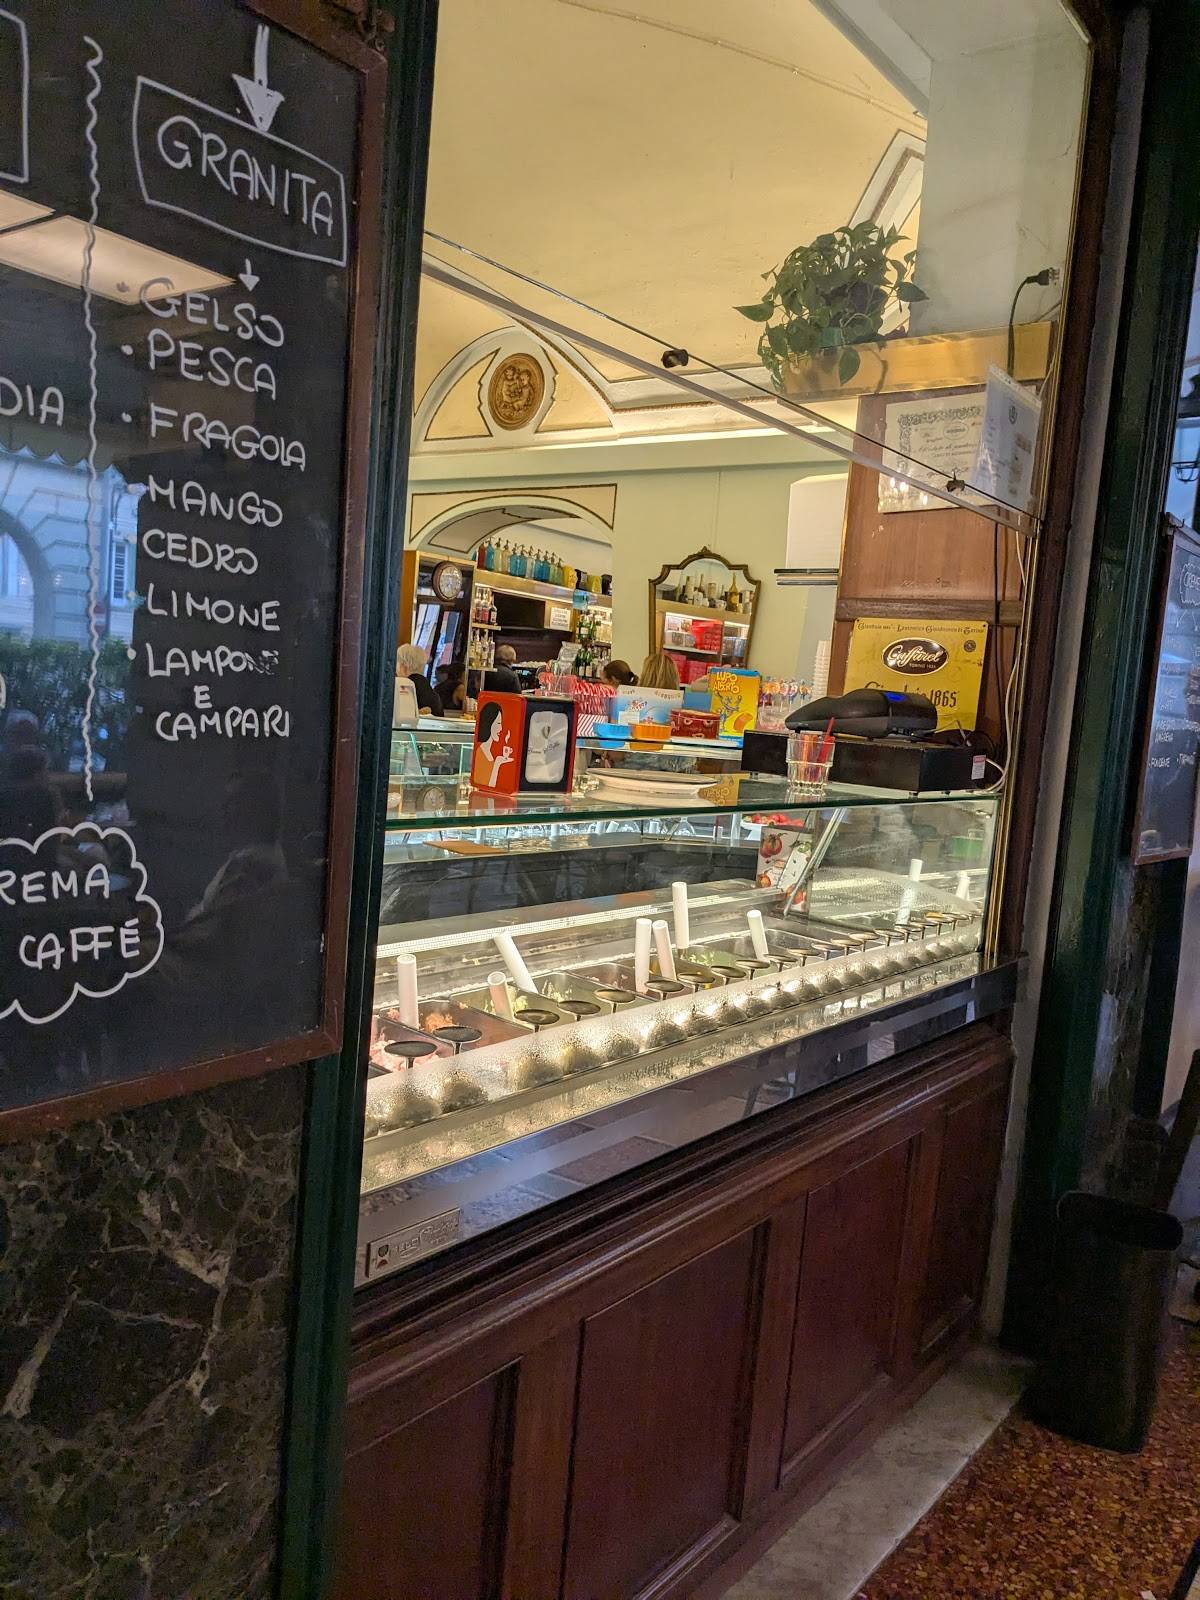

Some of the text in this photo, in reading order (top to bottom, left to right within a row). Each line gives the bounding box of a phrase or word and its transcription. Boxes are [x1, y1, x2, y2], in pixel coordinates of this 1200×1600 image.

[157, 115, 333, 237] GRANITA
[140, 277, 285, 347] GELSO
[147, 328, 277, 400] PESCA
[151, 404, 306, 472] FRAGOLA
[148, 475, 283, 527] MANGO
[142, 529, 259, 575] CEDRO
[147, 583, 280, 631] LIMONE
[887, 644, 944, 667] Caffarel
[193, 685, 212, 709] E
[712, 680, 740, 694] ALBERTO
[716, 671, 738, 685] LUPO
[930, 689, 957, 708] 1865
[155, 705, 290, 741] CAMPARI
[0, 863, 110, 905] REMA
